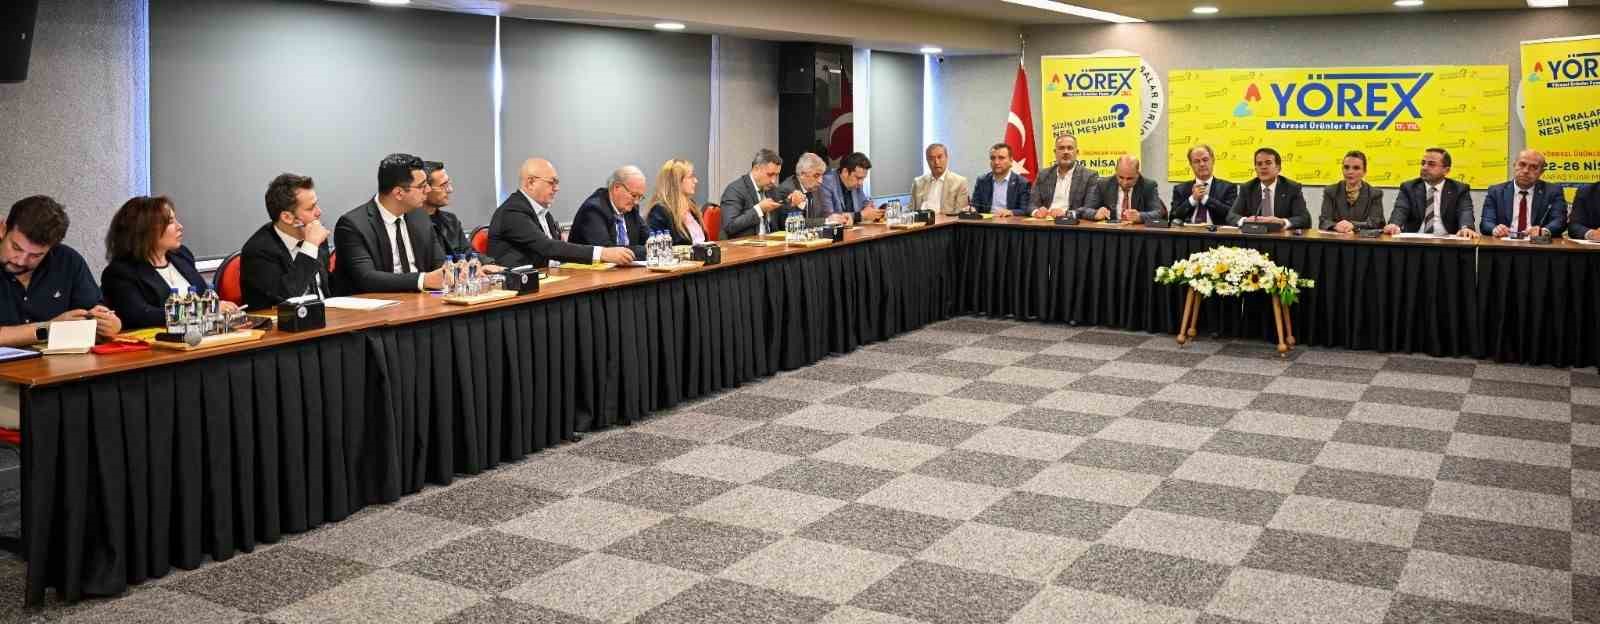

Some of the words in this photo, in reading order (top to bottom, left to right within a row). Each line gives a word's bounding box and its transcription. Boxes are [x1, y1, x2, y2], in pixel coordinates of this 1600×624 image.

[1064, 68, 1136, 96] YÖREX
[1270, 72, 1434, 131] YÖREX
[1536, 116, 1561, 127] SİZİN
[1539, 123, 1564, 137] NESİ
